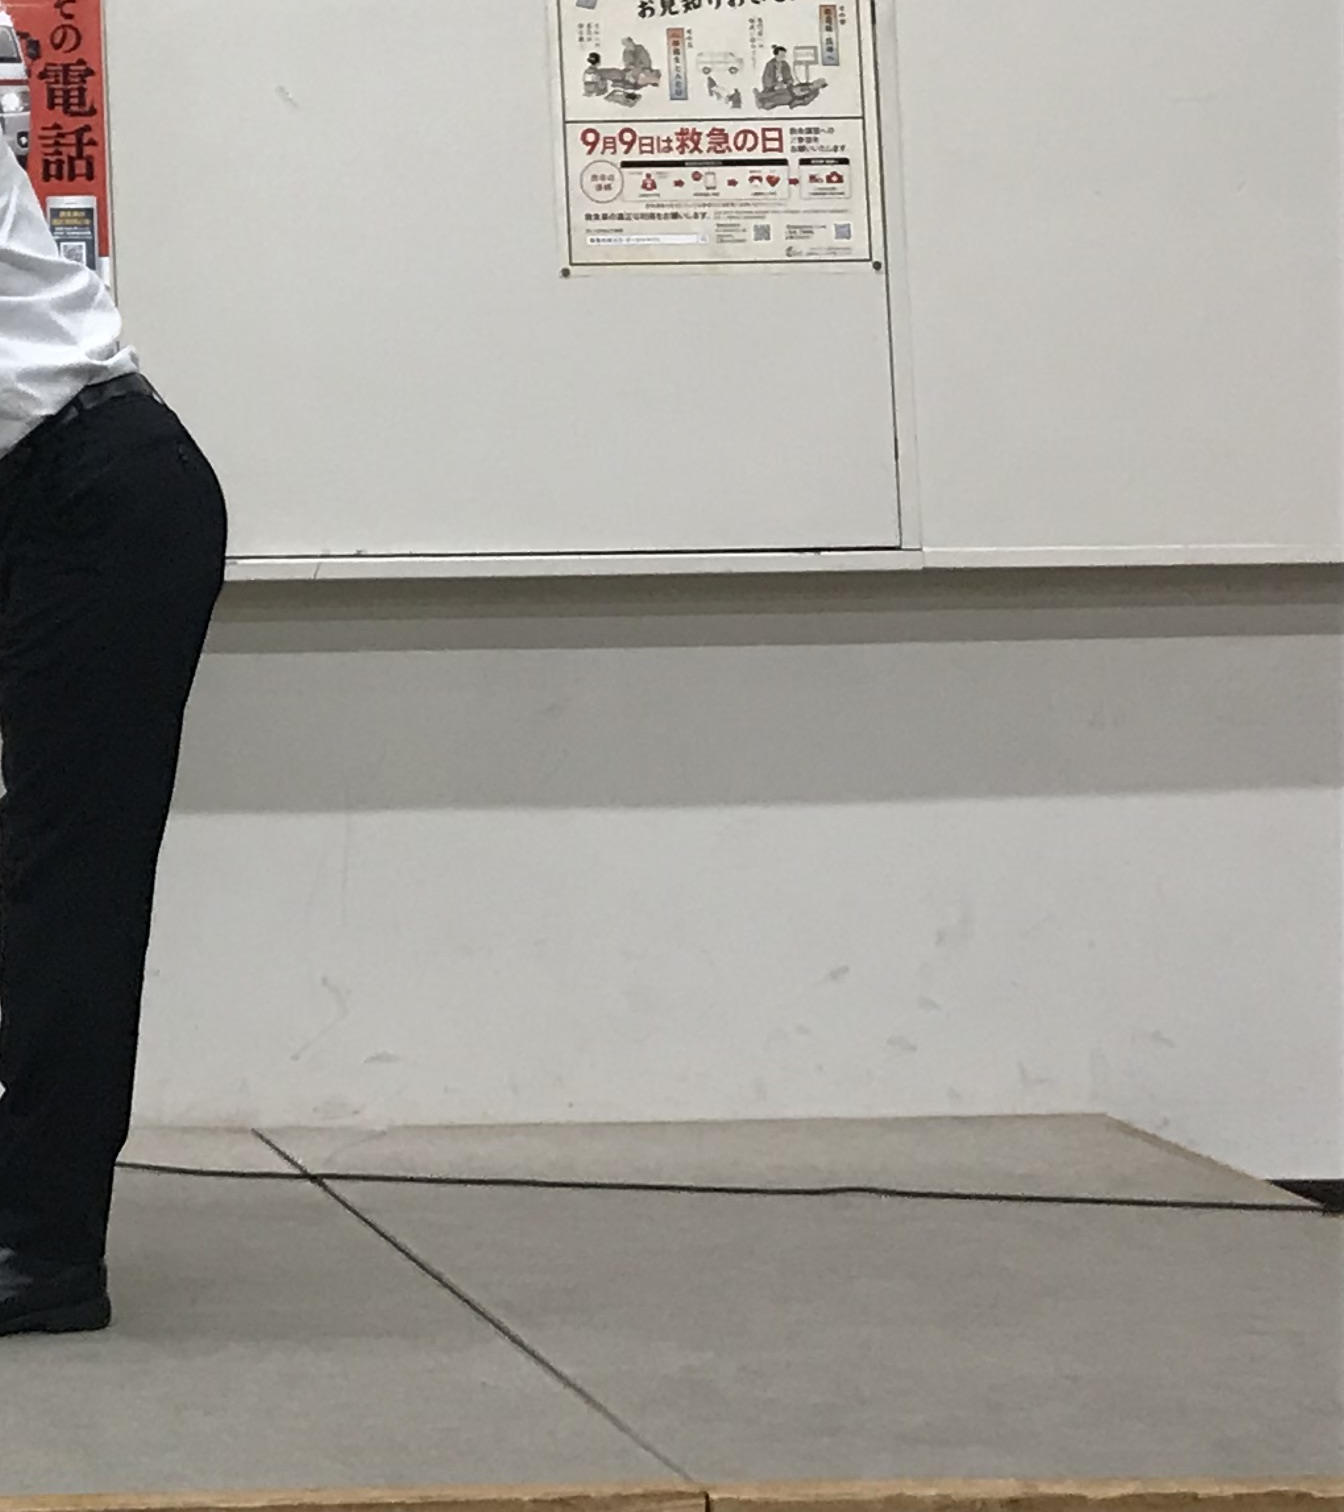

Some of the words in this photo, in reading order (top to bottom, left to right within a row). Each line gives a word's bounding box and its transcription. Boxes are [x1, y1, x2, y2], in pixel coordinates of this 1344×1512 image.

[581, 127, 784, 156] 9月9日は救急の日
